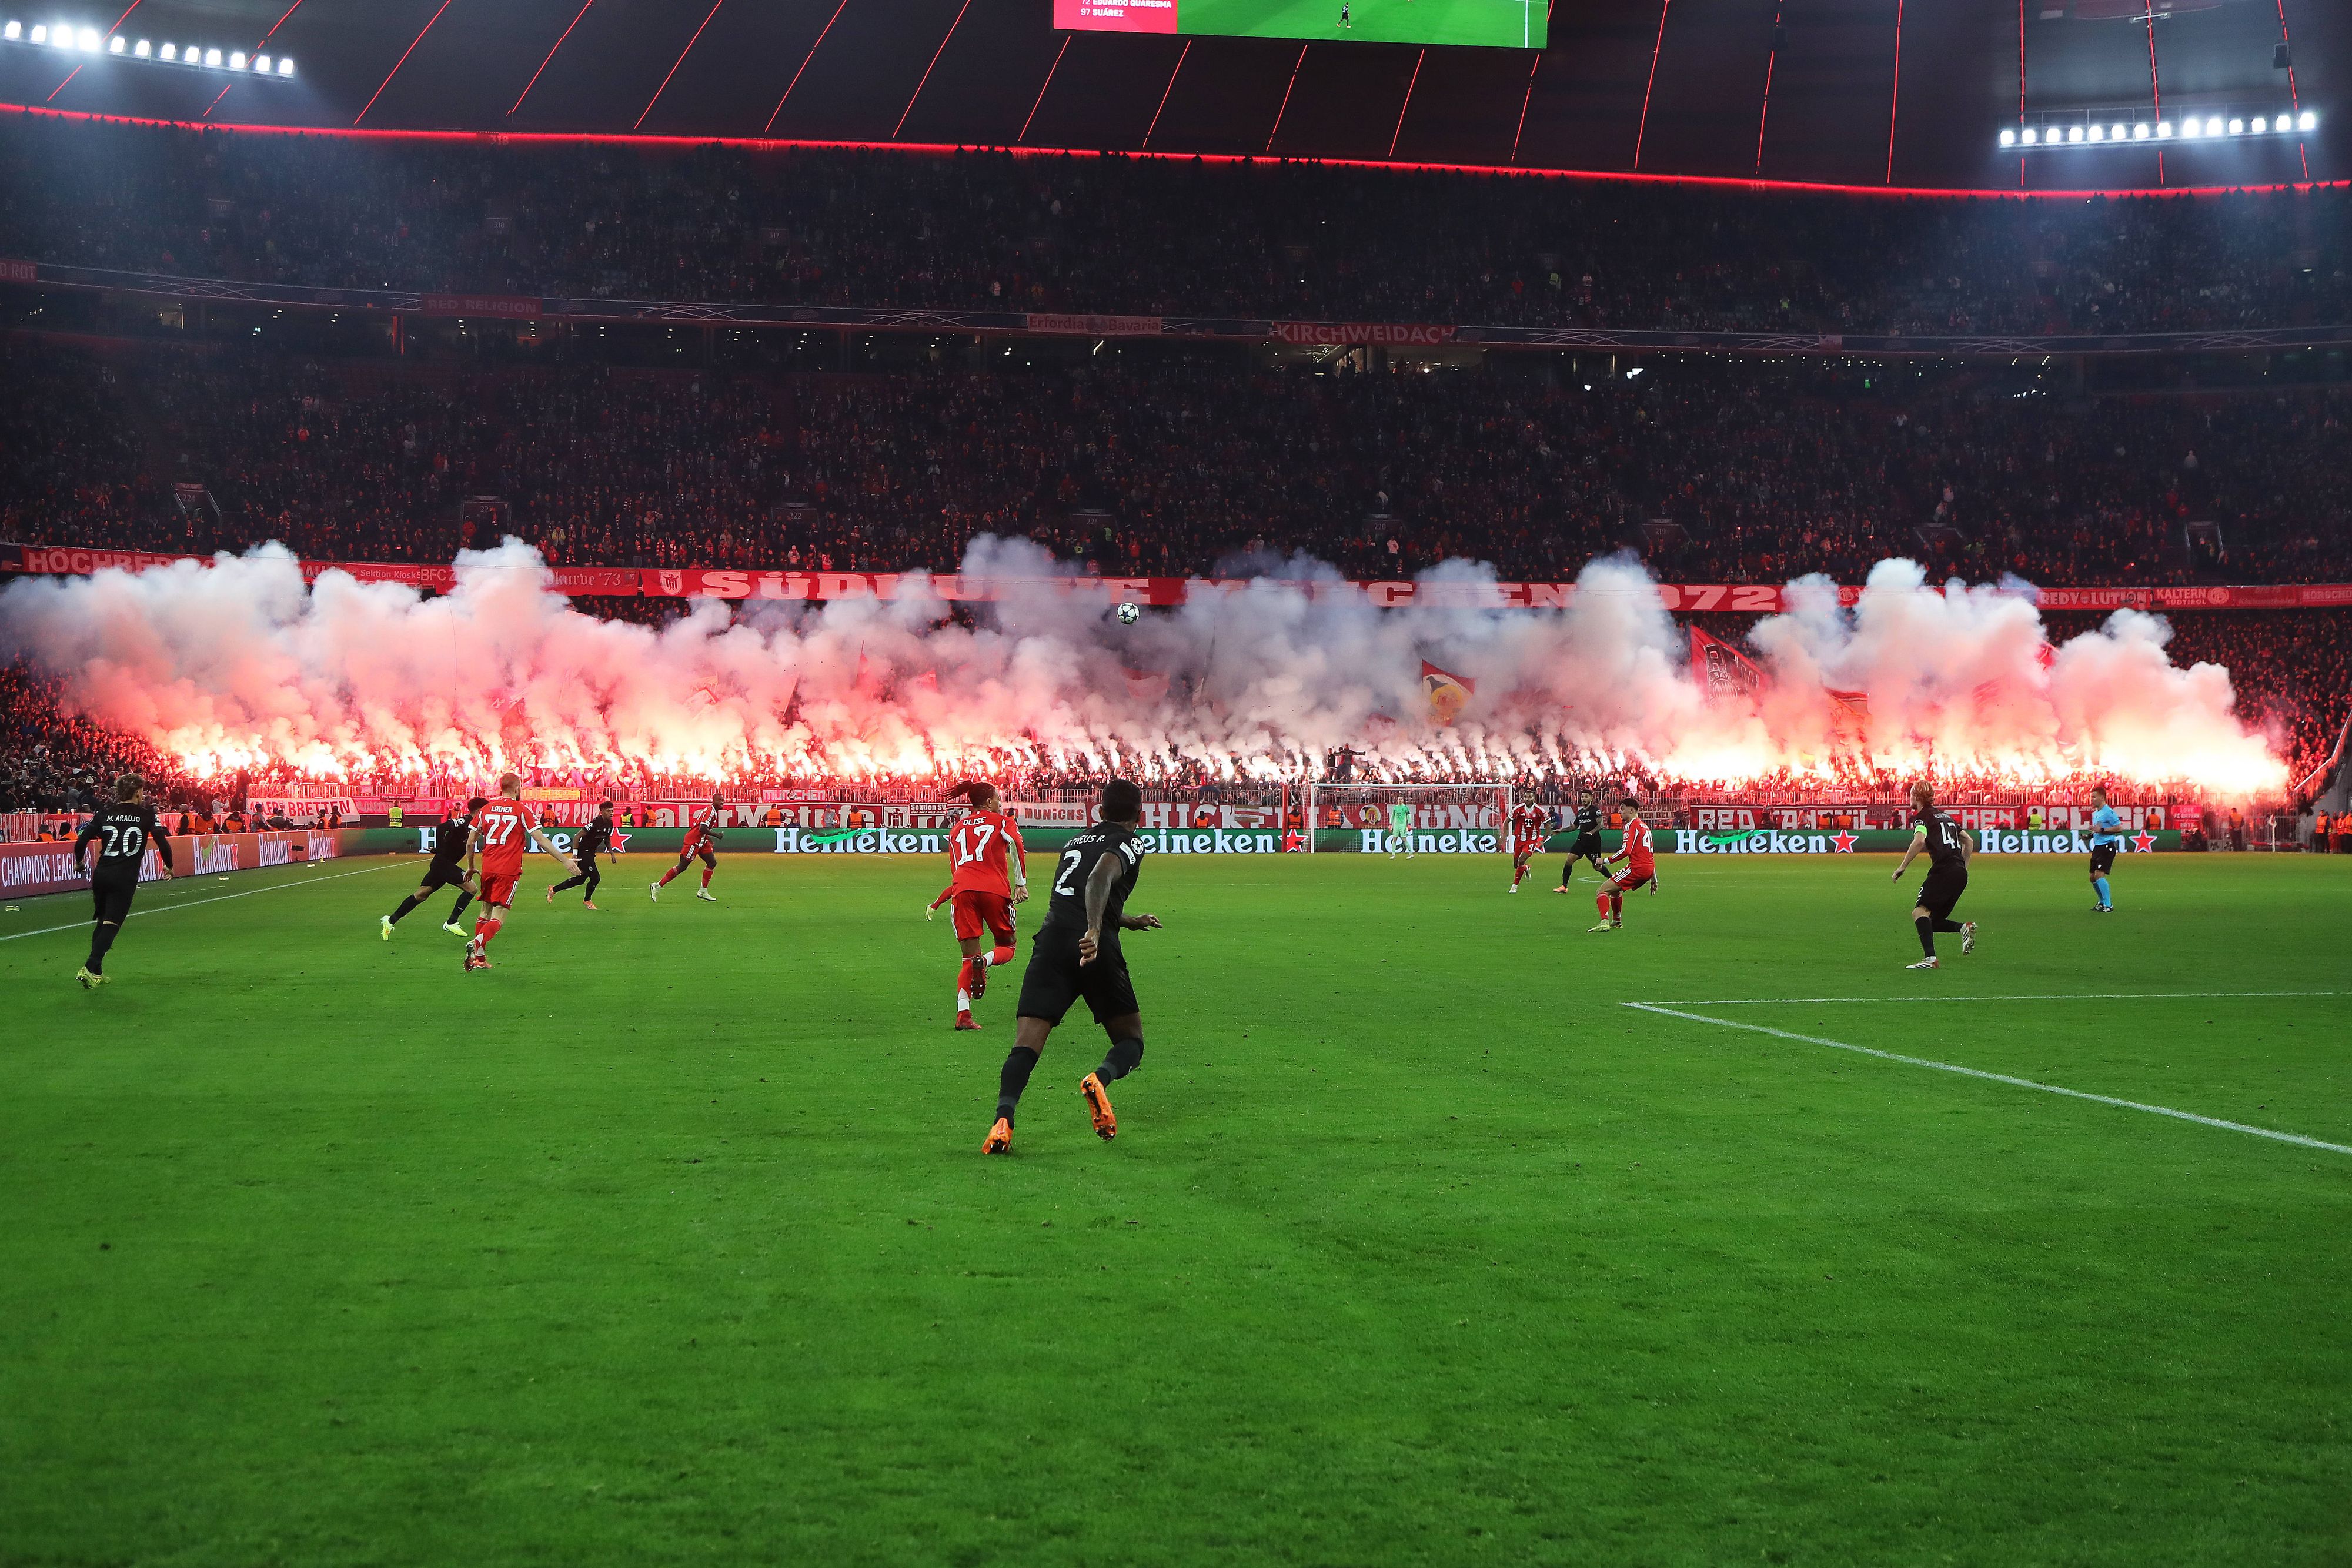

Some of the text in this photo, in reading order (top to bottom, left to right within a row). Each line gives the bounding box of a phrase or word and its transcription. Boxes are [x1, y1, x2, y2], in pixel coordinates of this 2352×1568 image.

[1092, 8, 1124, 18] SUÁREZ
[1130, 1, 1171, 9] QUARESMA
[757, 141, 774, 151] 317
[12, 263, 36, 279] ROT
[429, 299, 537, 313] RED RELIGION
[1030, 316, 1160, 332] Erfordia Bavaria
[1279, 324, 1455, 343] KIRCHWEIDACH
[360, 569, 390, 579] Sektion
[421, 569, 446, 581] BFC
[553, 571, 622, 586] kurve '73
[2156, 589, 2206, 600] KALTERN
[288, 800, 351, 817] BRETTEN
[115, 814, 141, 823] ARAÚJO
[963, 817, 988, 826] OLISE
[1698, 810, 1755, 830] RED
[485, 814, 518, 845] 27
[102, 825, 142, 857] 20
[259, 833, 288, 867] Heineken
[308, 830, 332, 860] Heineken
[774, 828, 941, 853] Heineken
[955, 824, 995, 865] 17
[1143, 828, 1276, 854] eineken
[1360, 828, 1515, 854] Heineken
[1675, 830, 1828, 854] Heineken
[1979, 830, 2127, 854] Heinekn
[192, 835, 232, 875] Heineken
[2, 854, 51, 887] CHAMPIONS
[1055, 849, 1082, 896] 2
